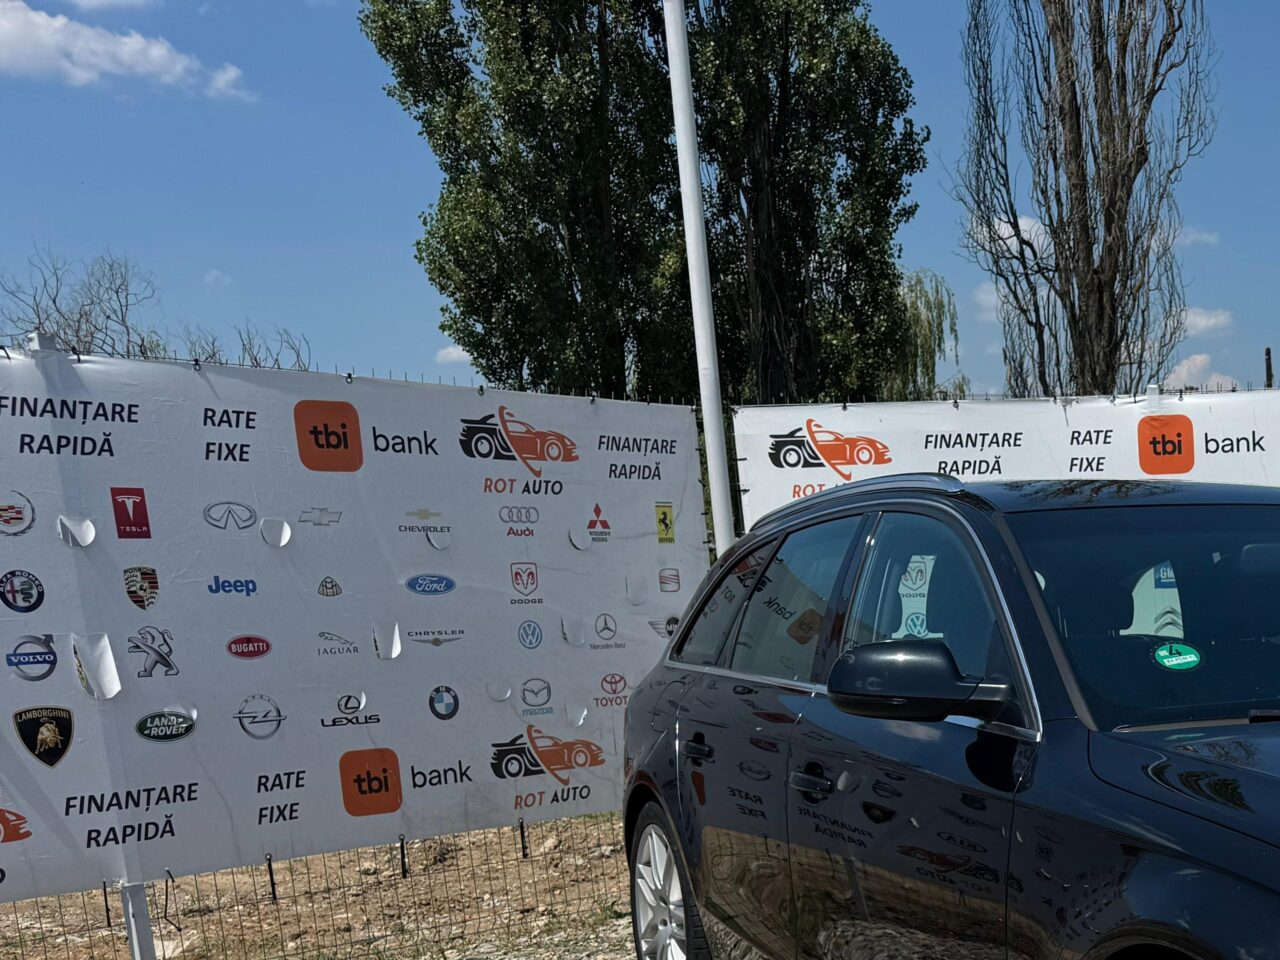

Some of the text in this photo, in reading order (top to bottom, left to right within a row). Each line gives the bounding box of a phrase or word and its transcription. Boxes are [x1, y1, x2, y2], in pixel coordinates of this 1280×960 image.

[0, 396, 139, 425] FINANȚARE
[203, 407, 257, 430] RATE
[19, 432, 115, 458] RAPIDĂ
[309, 423, 439, 455] tbi bank
[598, 435, 677, 456] FINANȚARE
[924, 432, 1023, 452] FINANȚARE
[1069, 429, 1113, 446] RATE
[1149, 430, 1266, 456] tbi bank
[205, 442, 250, 462] FIXE
[608, 461, 662, 480] RAPIDĂ
[937, 455, 1002, 475] RAPIDĂ
[1069, 456, 1106, 473] FIXE
[483, 478, 563, 495] ROT AUTO
[398, 525, 452, 533] CHEVROLET
[507, 527, 534, 537] Audi
[15, 571, 43, 592] ROMEO
[208, 576, 257, 596] Jeep
[415, 576, 446, 592] Ford
[230, 642, 267, 653] BUGATTI
[317, 646, 359, 656] JAGUAR
[10, 653, 54, 663] VOLVO
[431, 686, 457, 698] BMW
[593, 696, 628, 708] TOYOT
[16, 707, 70, 721] LAMBORGHINI
[321, 714, 380, 727] LEXUS
[522, 706, 554, 717] mazda
[150, 725, 186, 736] ROVER
[256, 770, 306, 793] RATE
[353, 760, 473, 795] tbi bank
[64, 782, 199, 816] FINANȚARE
[514, 785, 591, 810] ROT AUTO
[257, 802, 299, 825] FIXE
[86, 813, 176, 848] RAPIDĂ
